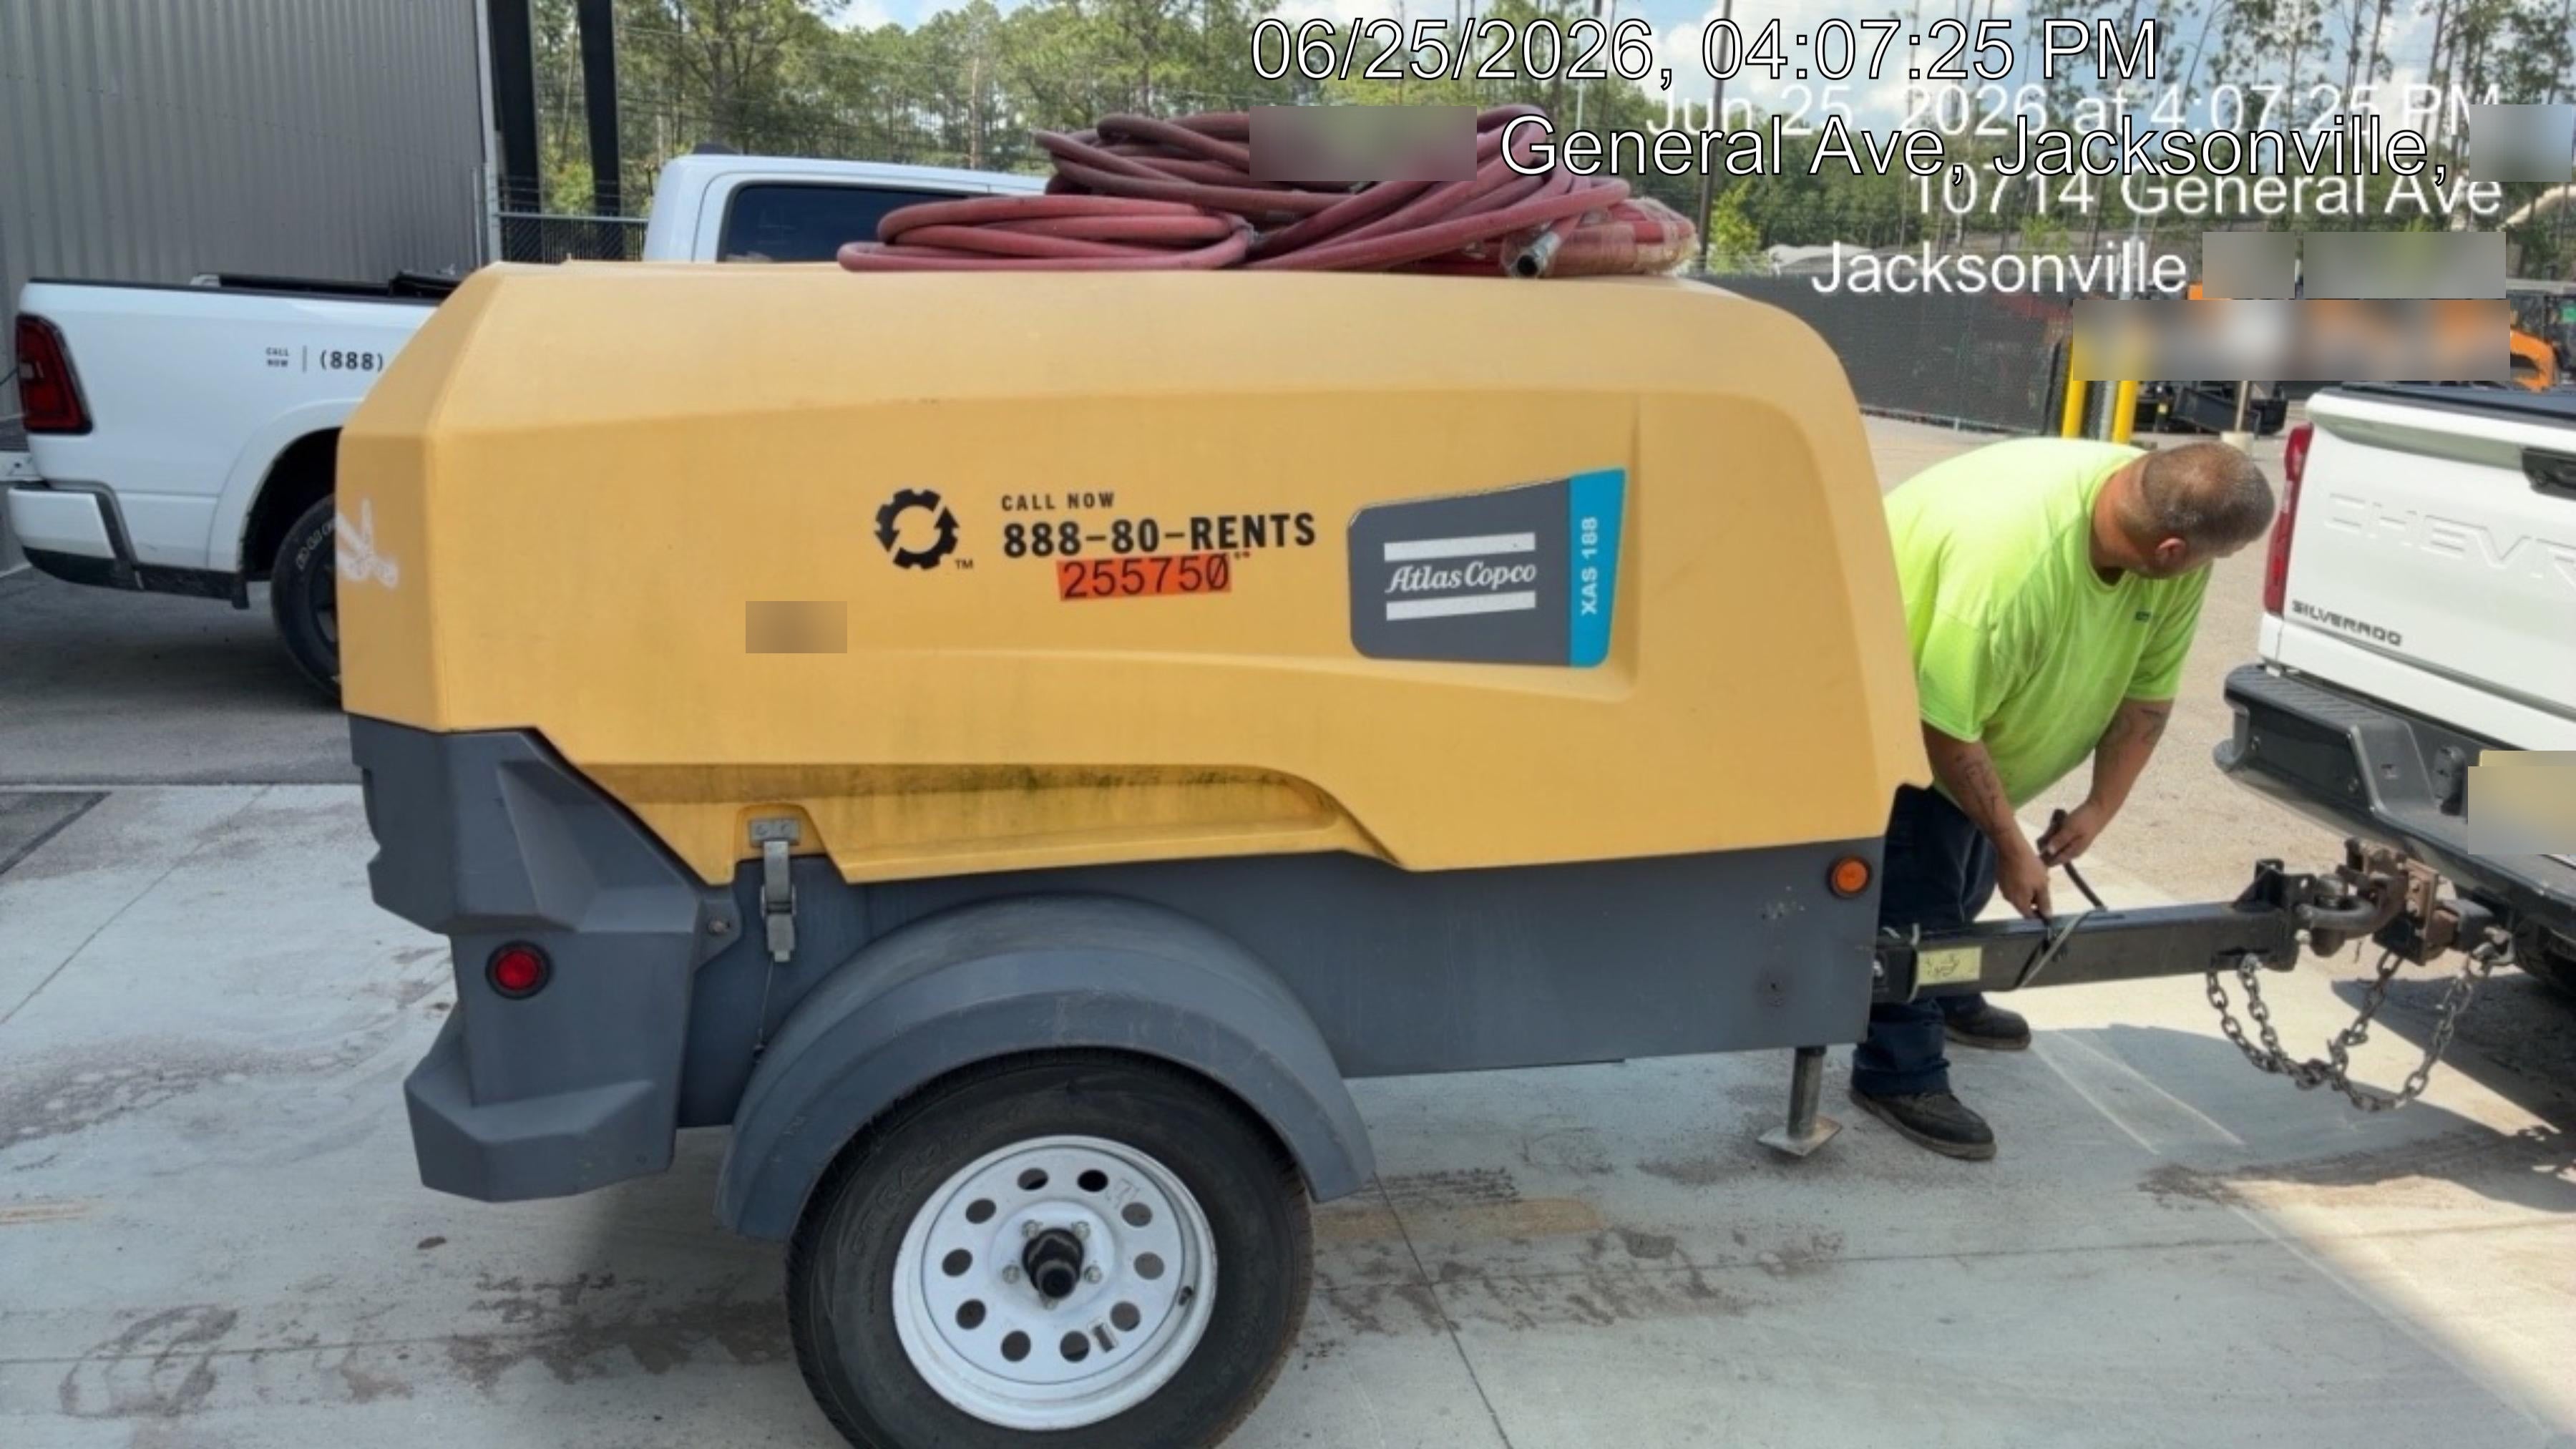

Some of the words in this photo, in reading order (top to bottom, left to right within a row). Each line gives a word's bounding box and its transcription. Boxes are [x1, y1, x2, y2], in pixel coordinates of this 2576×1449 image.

[320, 350, 384, 372] (888)
[1001, 493, 1055, 511] CALL
[1067, 491, 1115, 509] NOW
[1003, 512, 1315, 558] 888-80-RENTS
[1581, 516, 1598, 560] 188
[1063, 552, 1230, 599] 255750
[1581, 566, 1598, 615] XAS
[2292, 600, 2402, 646] SILVERADO
